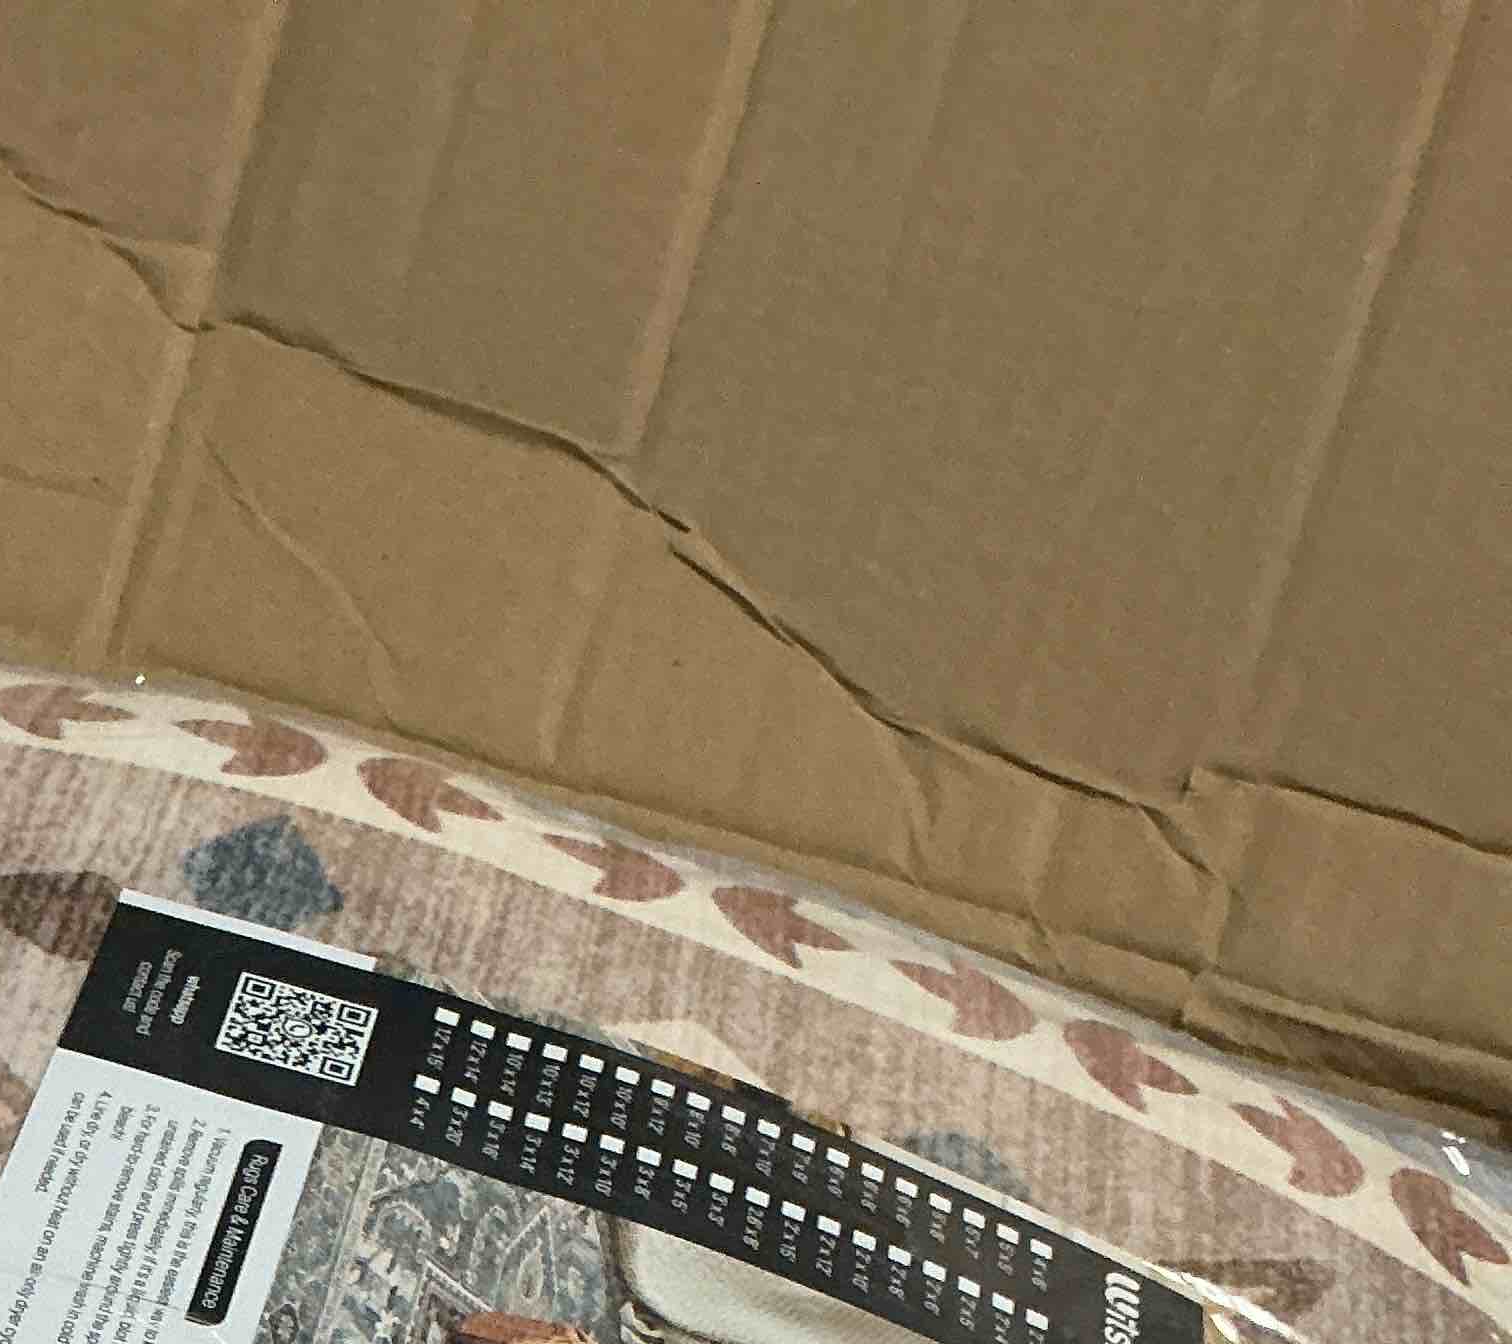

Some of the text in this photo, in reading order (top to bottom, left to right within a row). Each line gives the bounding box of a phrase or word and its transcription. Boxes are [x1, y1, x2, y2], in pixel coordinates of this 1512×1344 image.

[133, 1012, 156, 1037] and
[66, 1147, 90, 1169] dry
[45, 1202, 68, 1231] heat
[199, 1149, 270, 1313] Rugs Care & Maintenance
[3, 1296, 31, 1329] dryer
[142, 1326, 161, 1343] to
